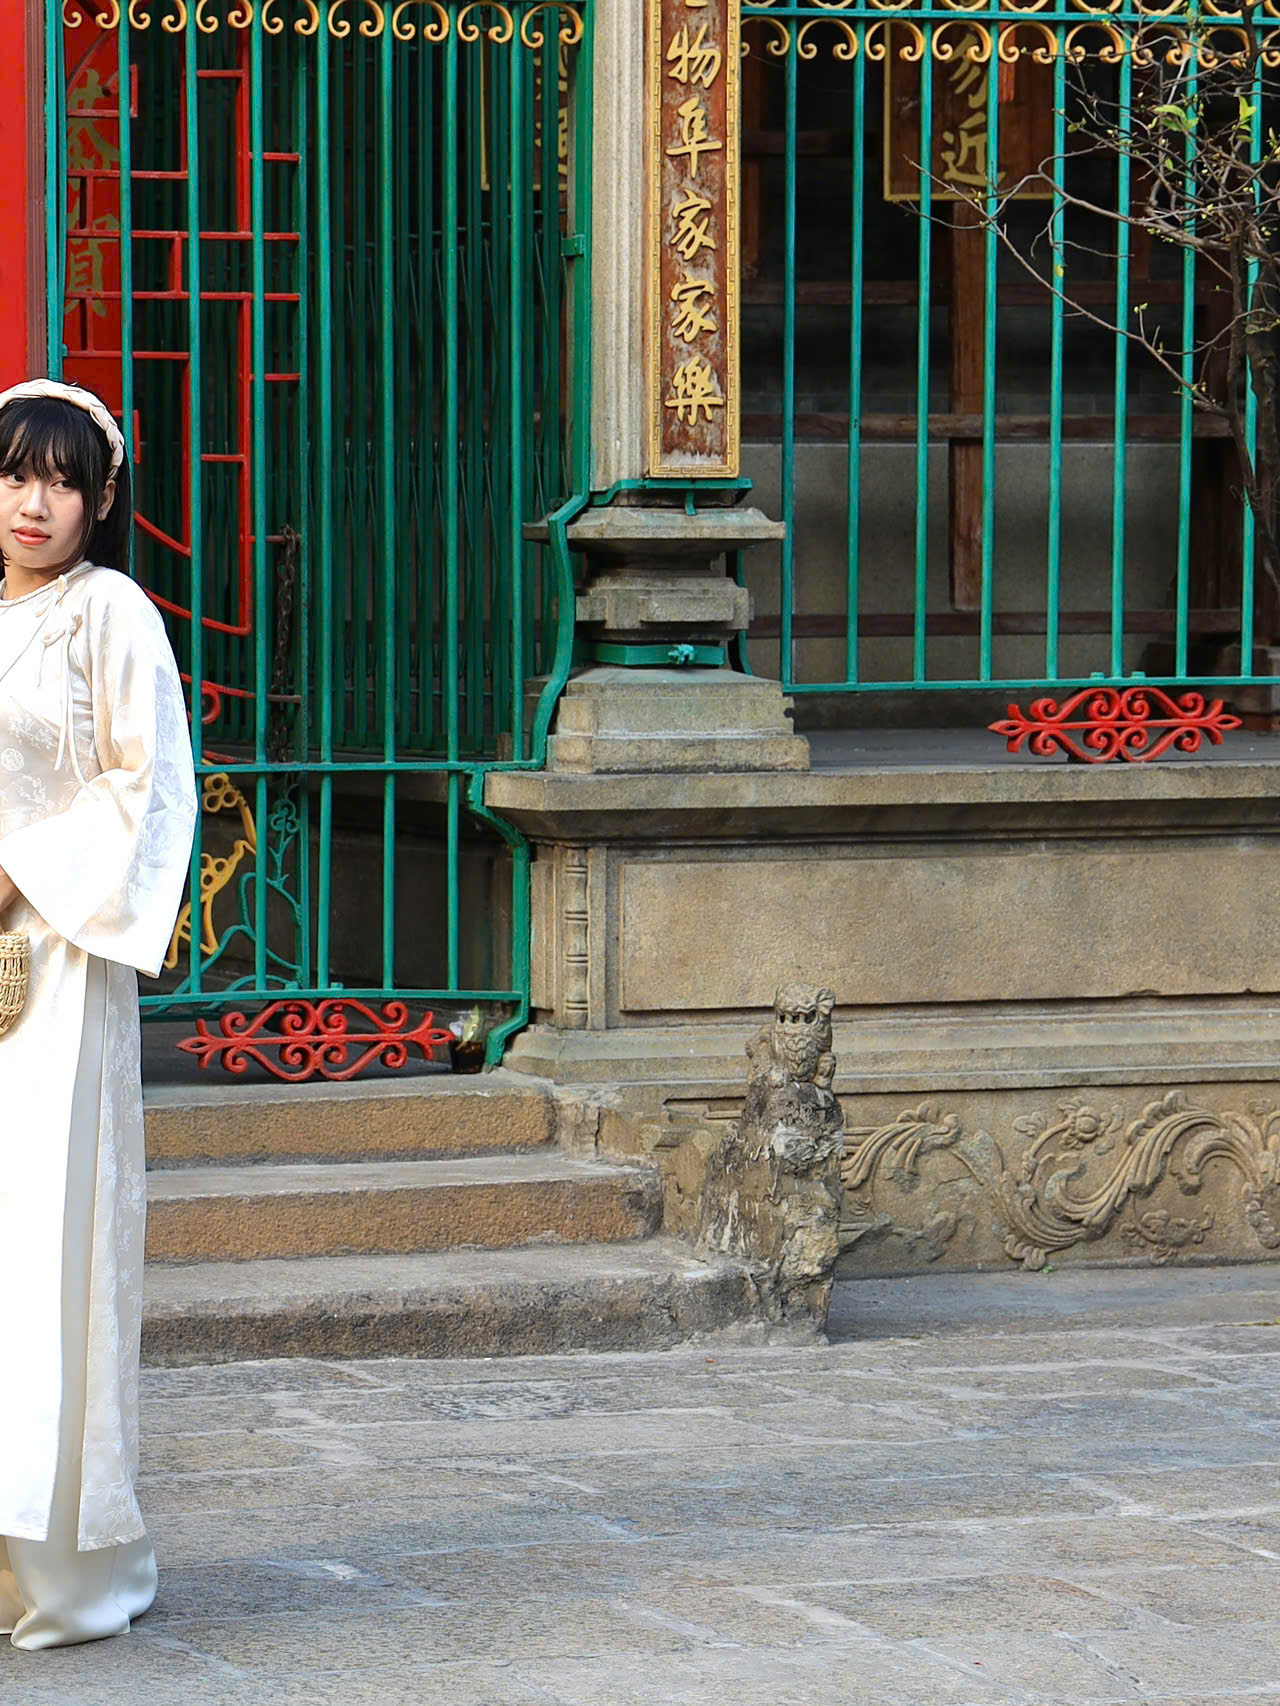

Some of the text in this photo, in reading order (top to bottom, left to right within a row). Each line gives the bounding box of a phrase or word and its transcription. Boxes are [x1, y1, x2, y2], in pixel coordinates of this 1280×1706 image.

[664, 0, 725, 427] 物阜家家樂
[940, 0, 1008, 188] 勿近
